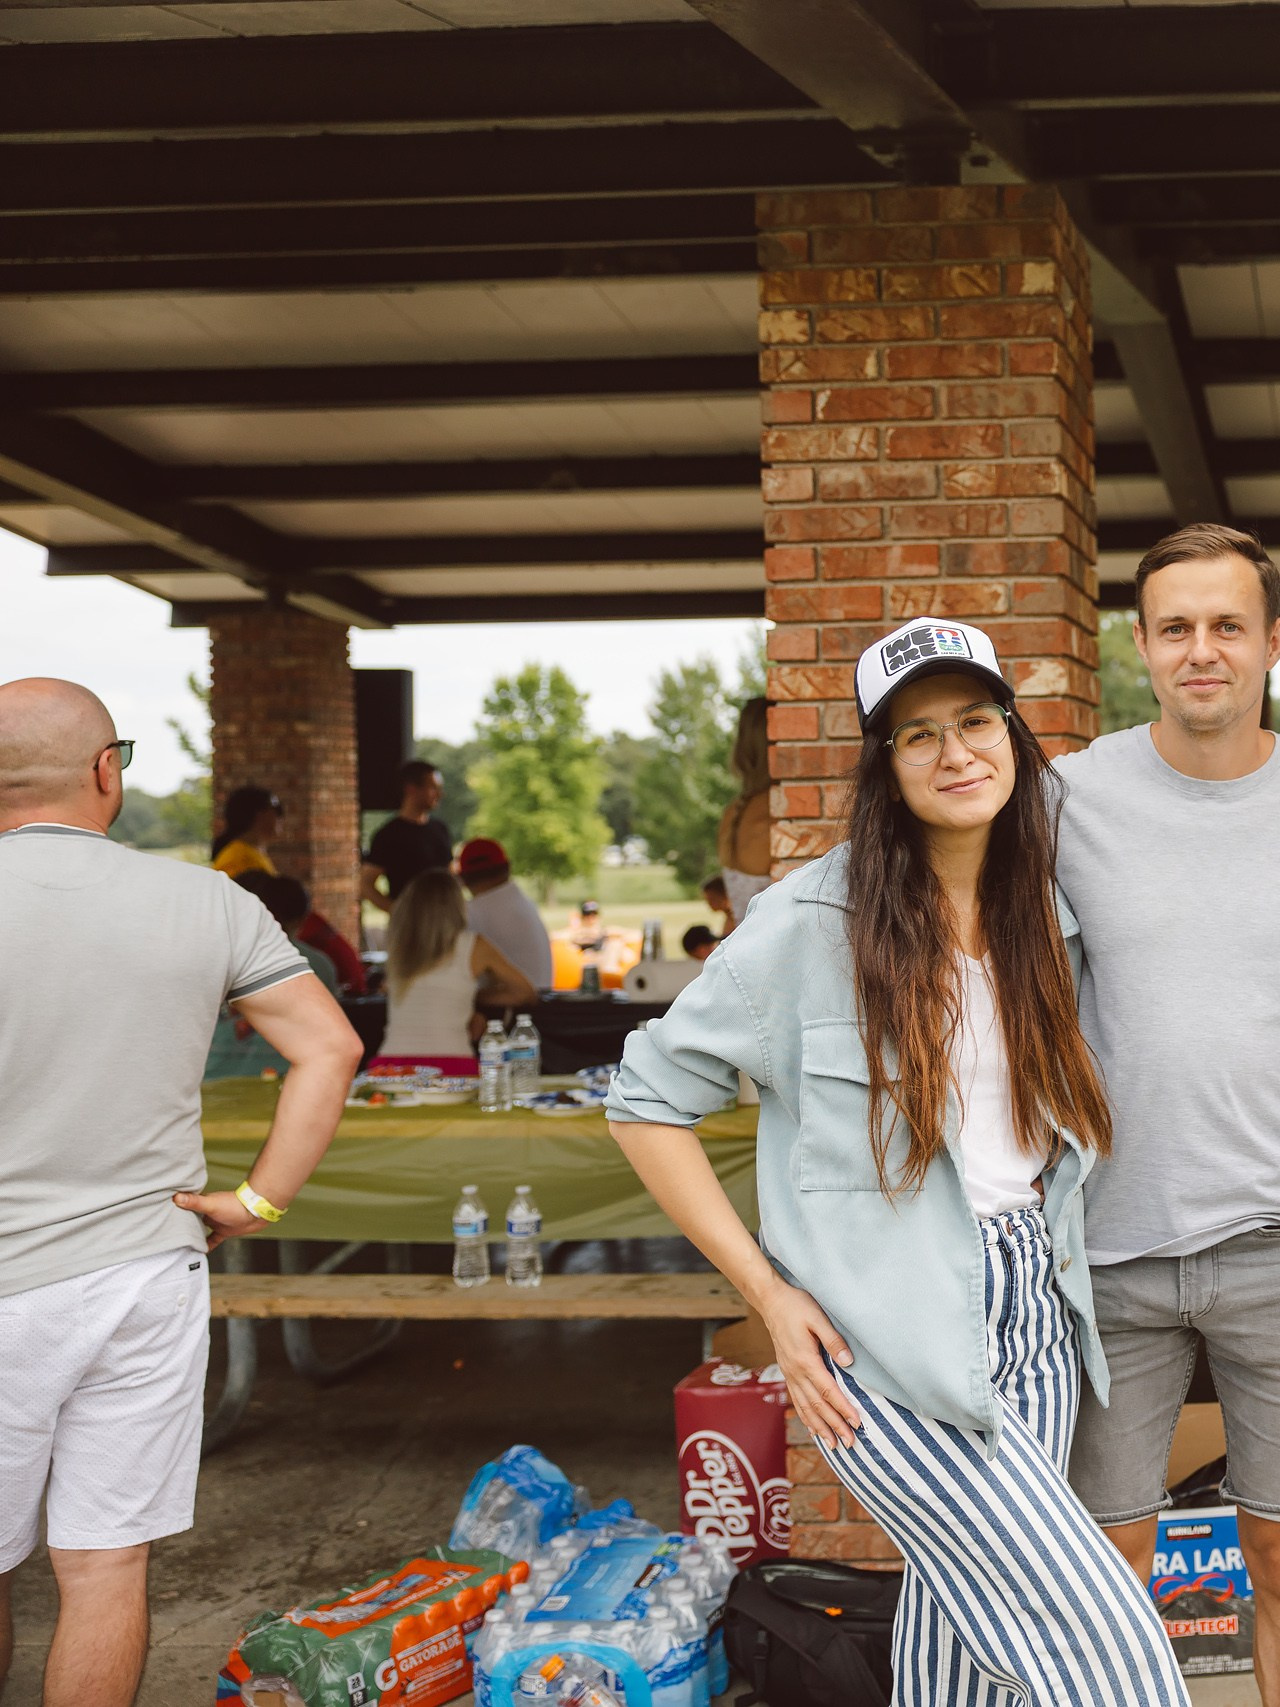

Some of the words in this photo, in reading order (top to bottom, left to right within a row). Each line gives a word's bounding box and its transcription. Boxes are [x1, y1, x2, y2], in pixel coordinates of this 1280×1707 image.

[886, 628, 934, 658] WE
[684, 1470, 721, 1518] Dr
[695, 1440, 758, 1549] Pepper
[1152, 1550, 1189, 1577] RA
[1193, 1547, 1247, 1574] LAR
[400, 1633, 463, 1673] GATORADE
[374, 1657, 399, 1692] G
